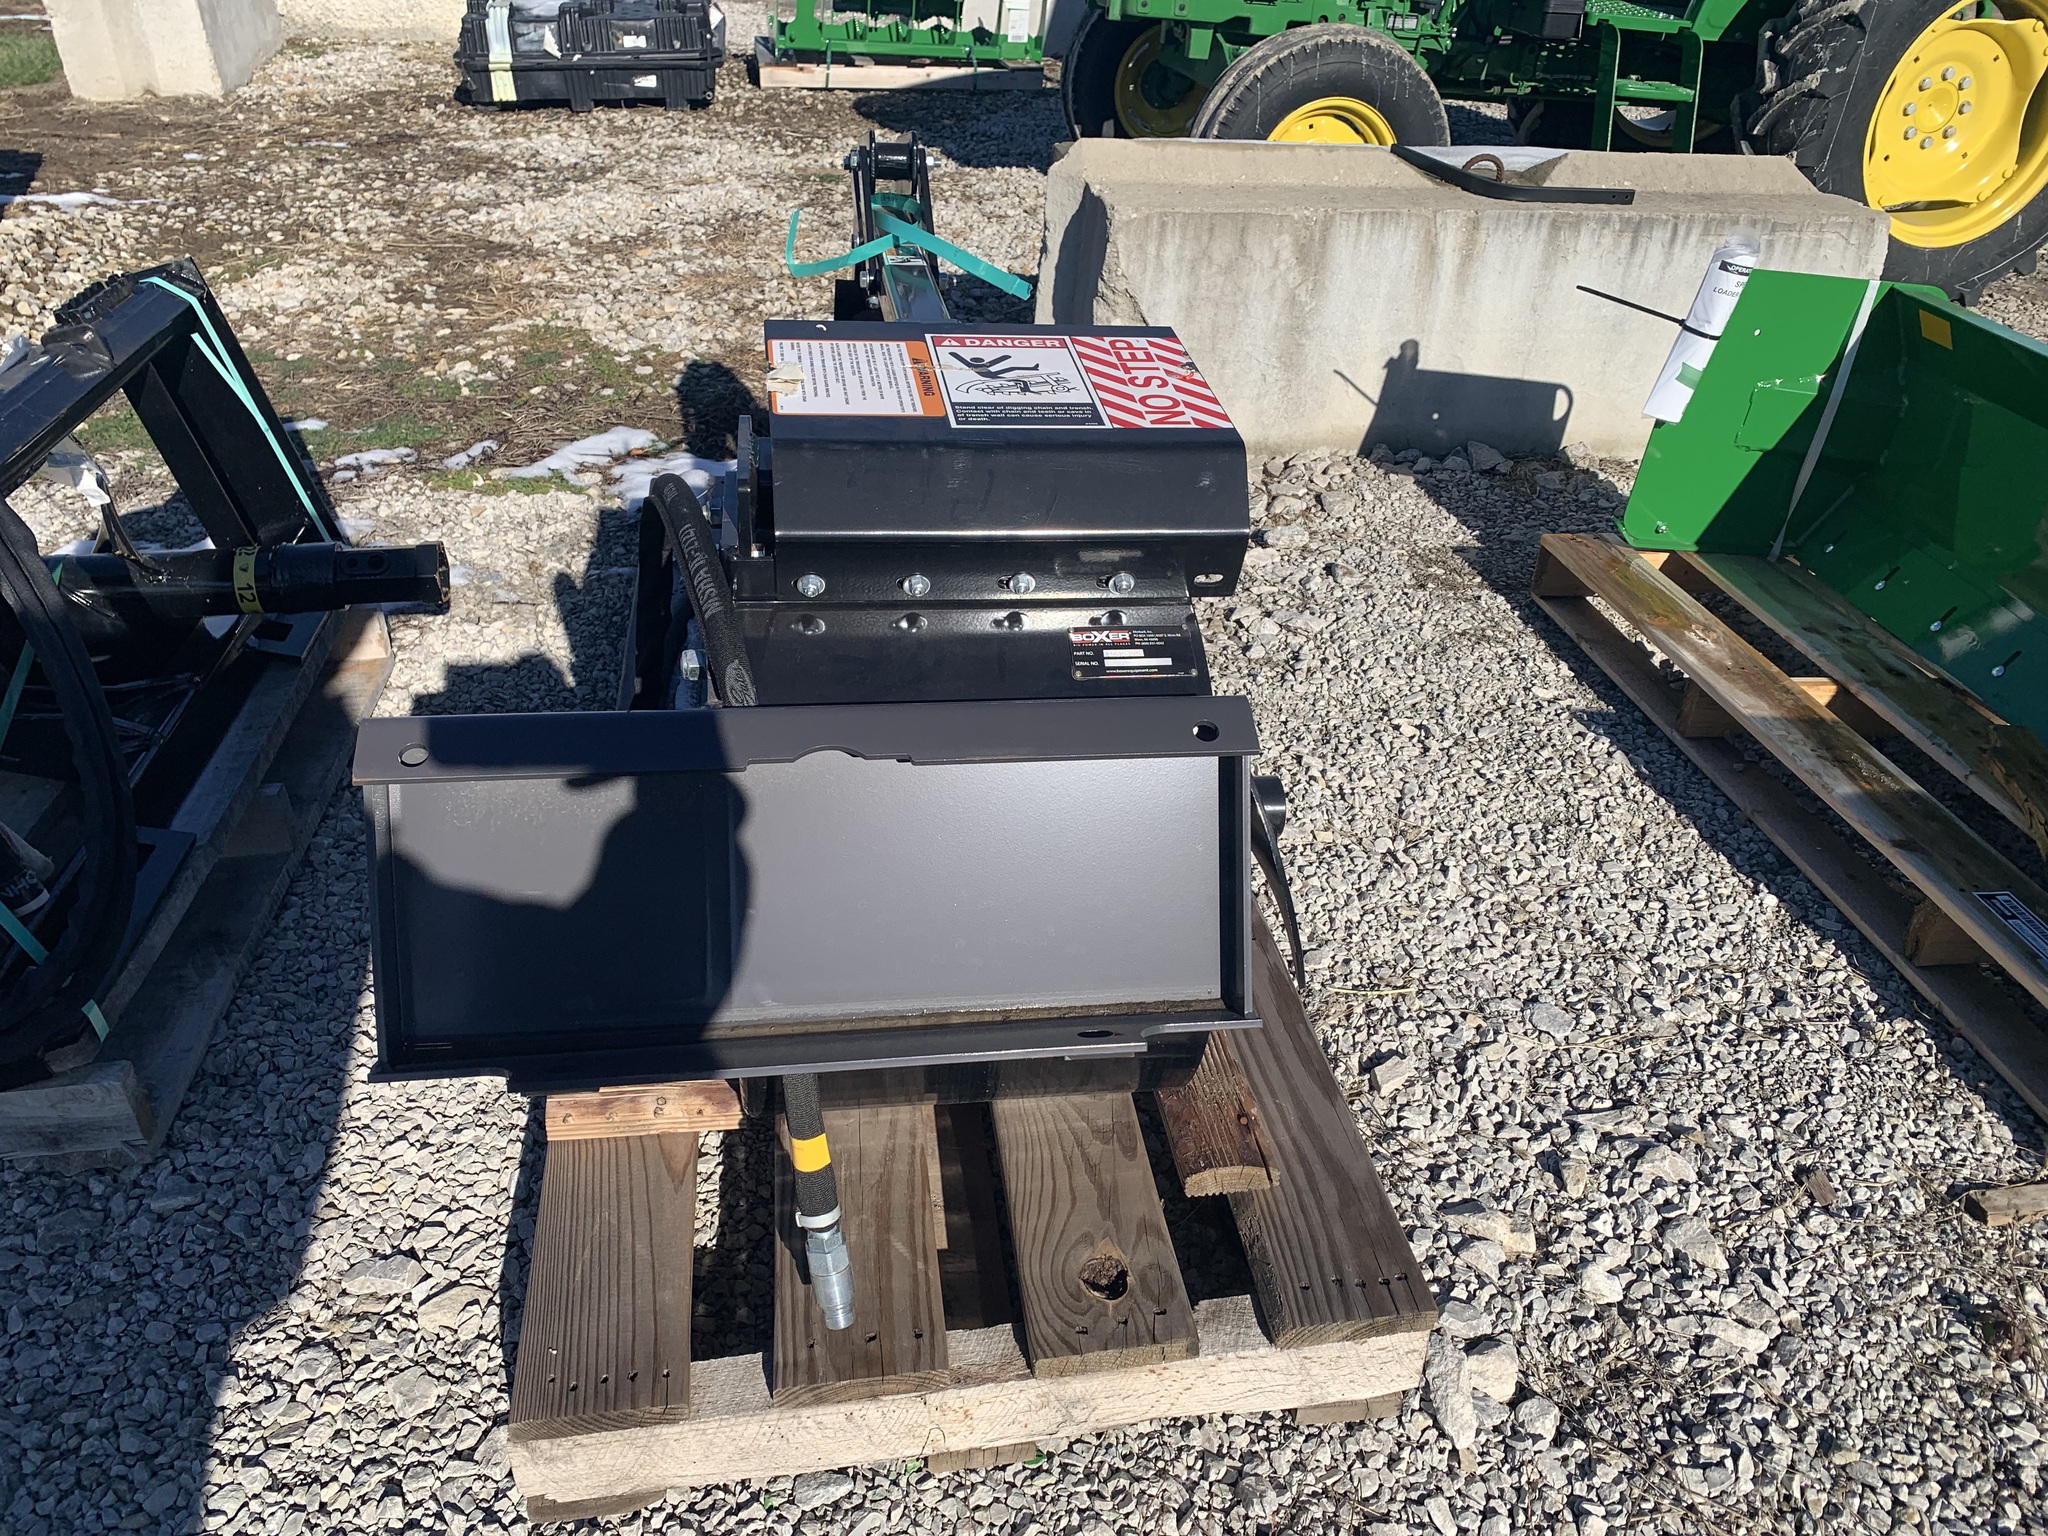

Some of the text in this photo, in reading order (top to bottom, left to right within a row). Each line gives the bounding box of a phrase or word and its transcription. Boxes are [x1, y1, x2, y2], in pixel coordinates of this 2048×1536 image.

[1731, 264, 1752, 274] OPERA
[964, 338, 1061, 347] DANGER
[1108, 339, 1192, 425] NO STEP
[237, 582, 257, 603] 12
[1070, 630, 1130, 643] BOXER
